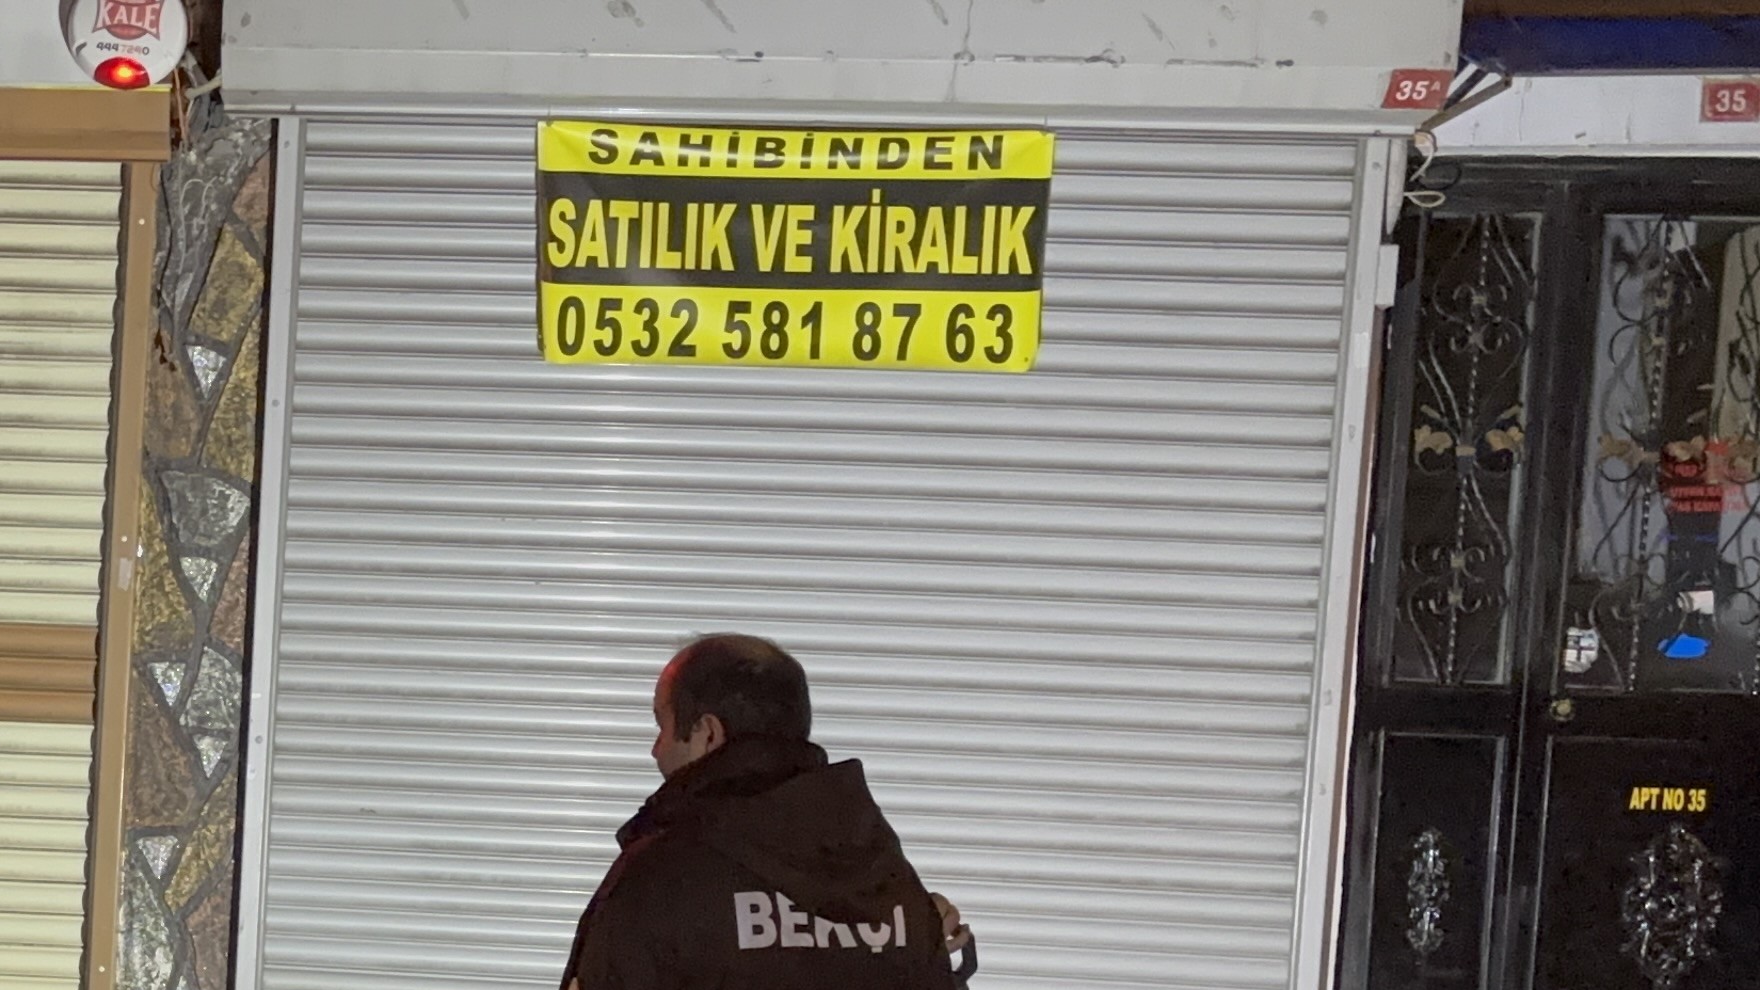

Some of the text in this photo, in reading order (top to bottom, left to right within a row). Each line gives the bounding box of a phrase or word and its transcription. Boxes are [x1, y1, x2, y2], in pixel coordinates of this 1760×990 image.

[96, 1, 161, 34] KALE
[1715, 89, 1747, 113] 35
[589, 128, 1005, 171] SAHİBİNDEN
[547, 188, 1036, 275] SATILIK VE KİRALIK
[556, 296, 1015, 364] 0532 581 87 63
[1629, 787, 1707, 812] APT NO 35
